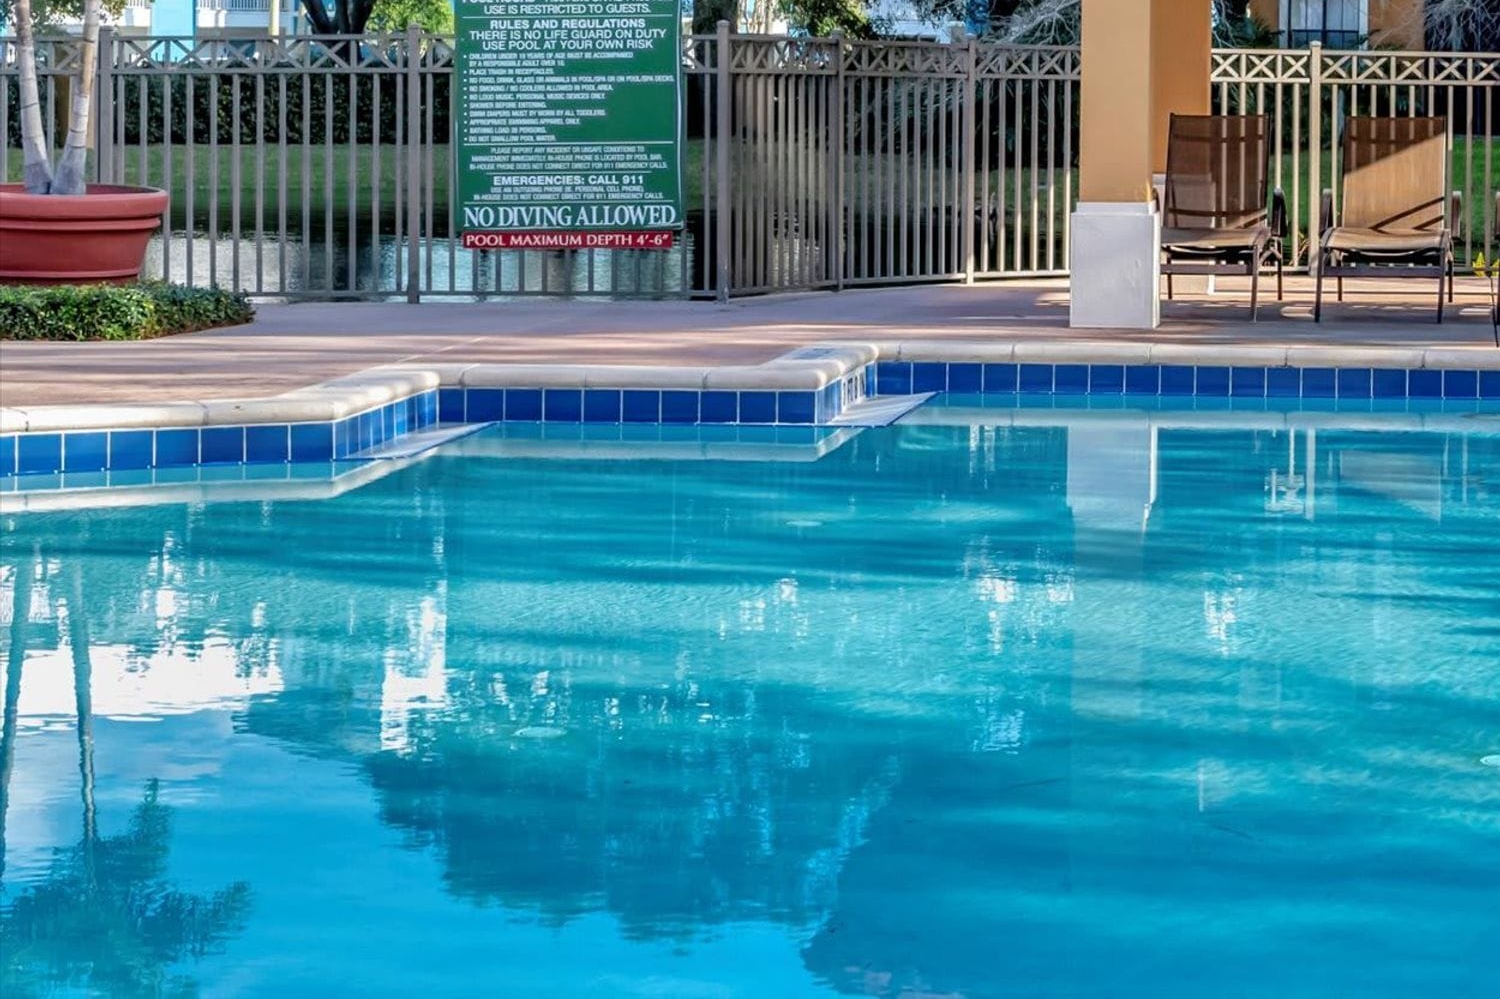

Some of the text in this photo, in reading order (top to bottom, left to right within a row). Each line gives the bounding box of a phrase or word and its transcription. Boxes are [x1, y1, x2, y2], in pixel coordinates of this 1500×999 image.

[484, 5, 651, 14] USE IS RESTRICTED TO GUESTS.
[490, 19, 645, 29] RULES AND REGULATIONS
[470, 29, 666, 39] THERE IS NO LIFE GUARD ON DUTY
[483, 39, 653, 50] USE POOL AT YOUR OWN RISK
[494, 175, 643, 185] EMERGENCIES: CALL 911
[464, 205, 676, 227] NO DIVING ALLOWED
[466, 235, 506, 246] POOL
[510, 234, 582, 246] MAXIMUM
[587, 234, 632, 246] DEPTH
